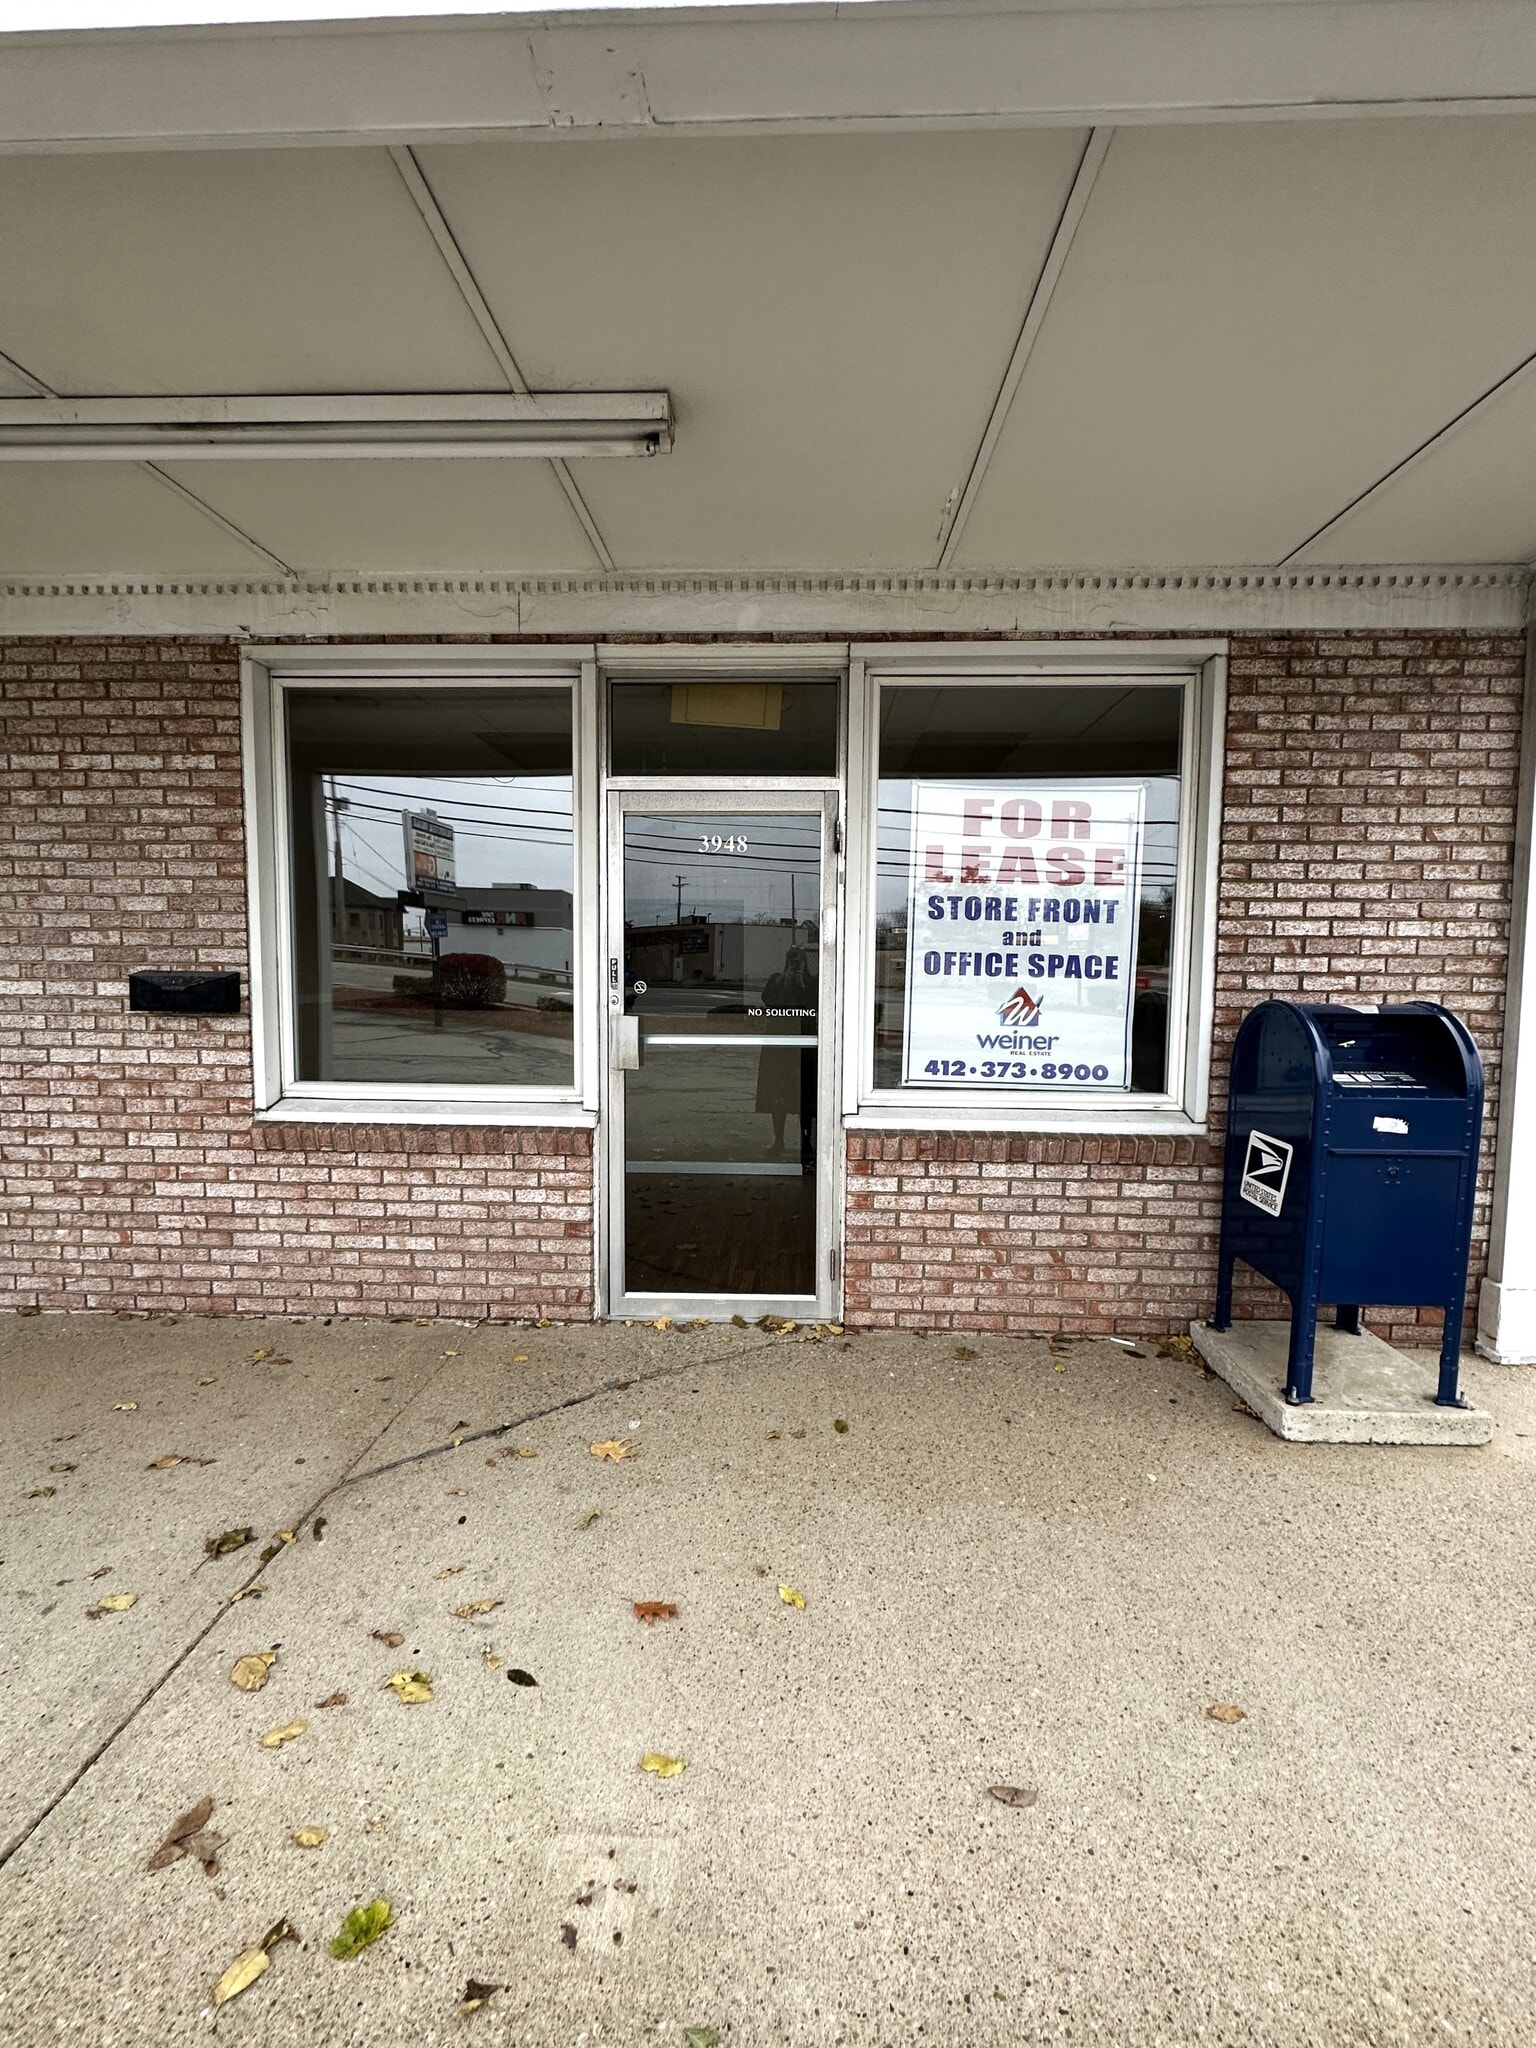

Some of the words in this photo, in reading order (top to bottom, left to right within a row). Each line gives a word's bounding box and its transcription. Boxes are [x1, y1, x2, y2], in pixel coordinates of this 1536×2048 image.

[963, 798, 1092, 840] FOR
[698, 835, 748, 853] 3948
[924, 845, 1126, 887] LEASE
[927, 895, 1018, 922] STORE
[1027, 898, 1120, 924] FRONT
[1002, 929, 1042, 947] and
[923, 950, 1019, 977] OFFICE
[1027, 953, 1120, 980] SPACE
[748, 1008, 763, 1017] NO
[765, 1008, 816, 1017] SOLICITING
[976, 1029, 1060, 1051] weiner
[1259, 1195, 1279, 1211] SERVICE
[1260, 1187, 1278, 1203] STATES
